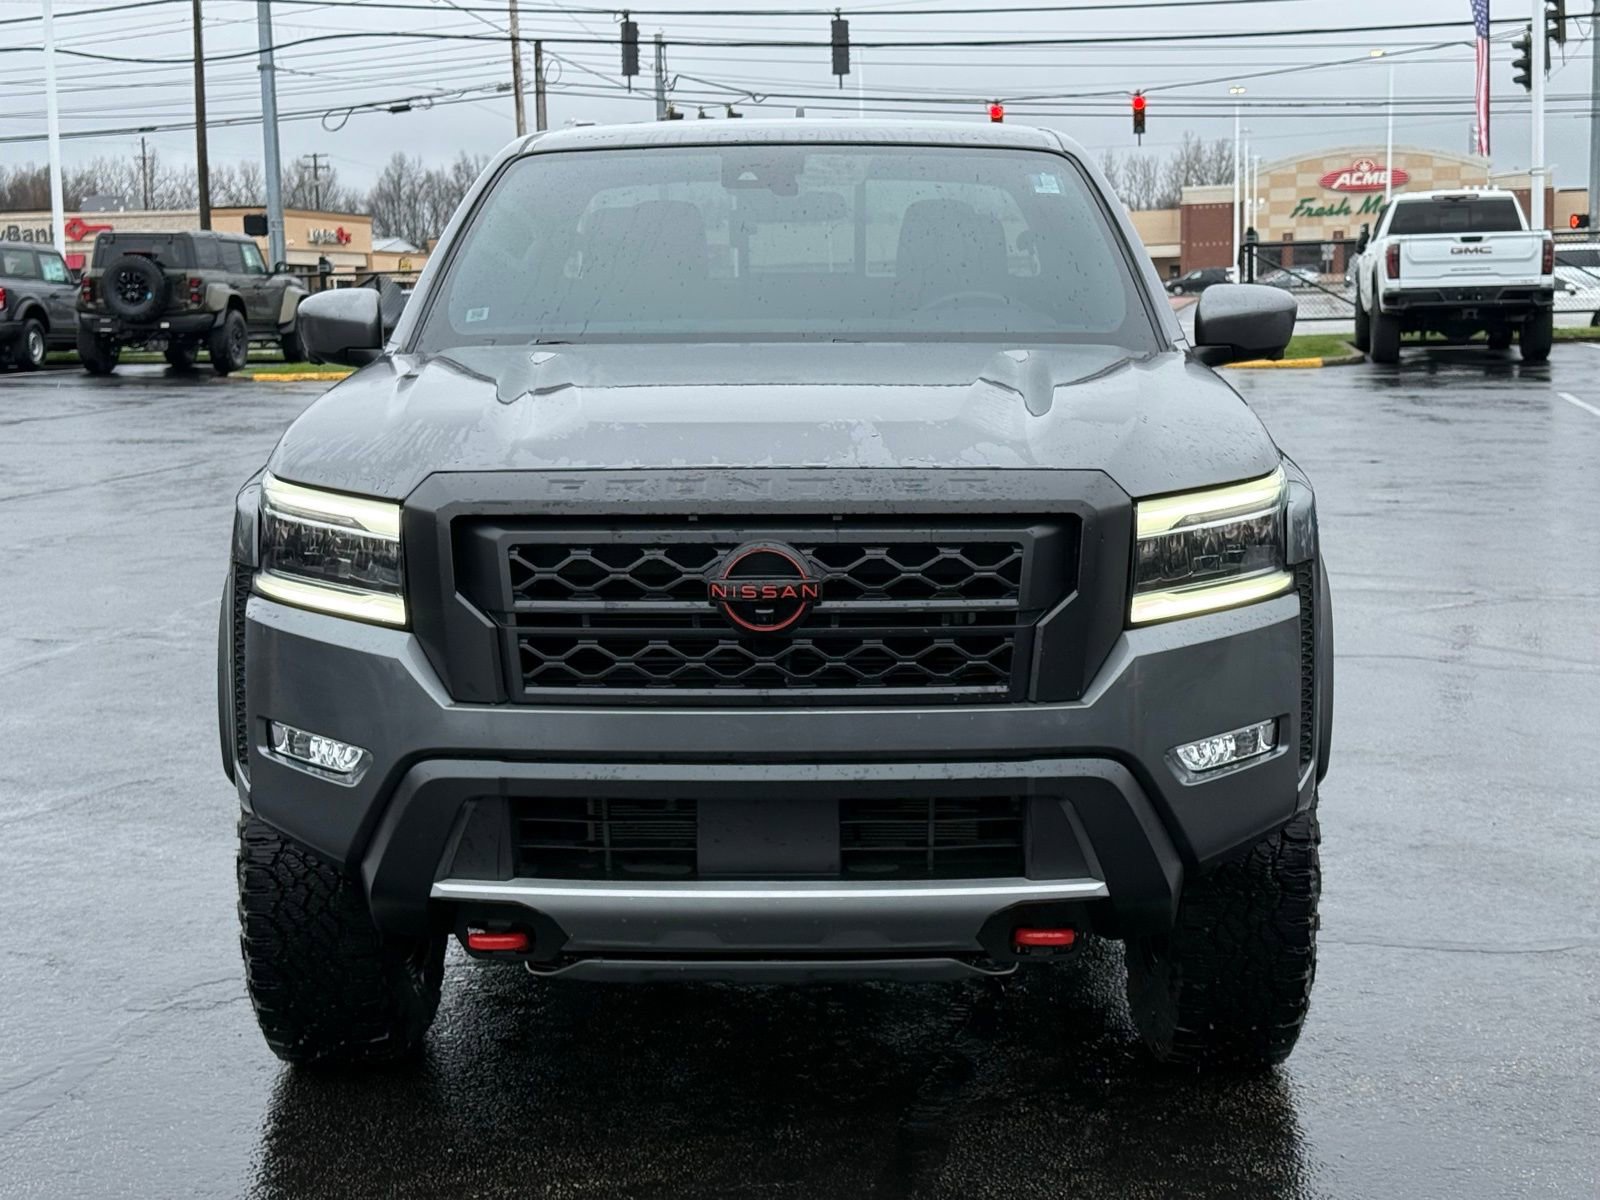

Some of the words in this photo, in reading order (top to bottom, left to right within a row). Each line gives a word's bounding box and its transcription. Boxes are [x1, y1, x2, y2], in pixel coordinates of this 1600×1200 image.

[1290, 197, 1352, 218] Fresh
[1450, 246, 1492, 255] GMC
[548, 478, 992, 497] FRONTIER
[711, 584, 818, 599] NISSAN
